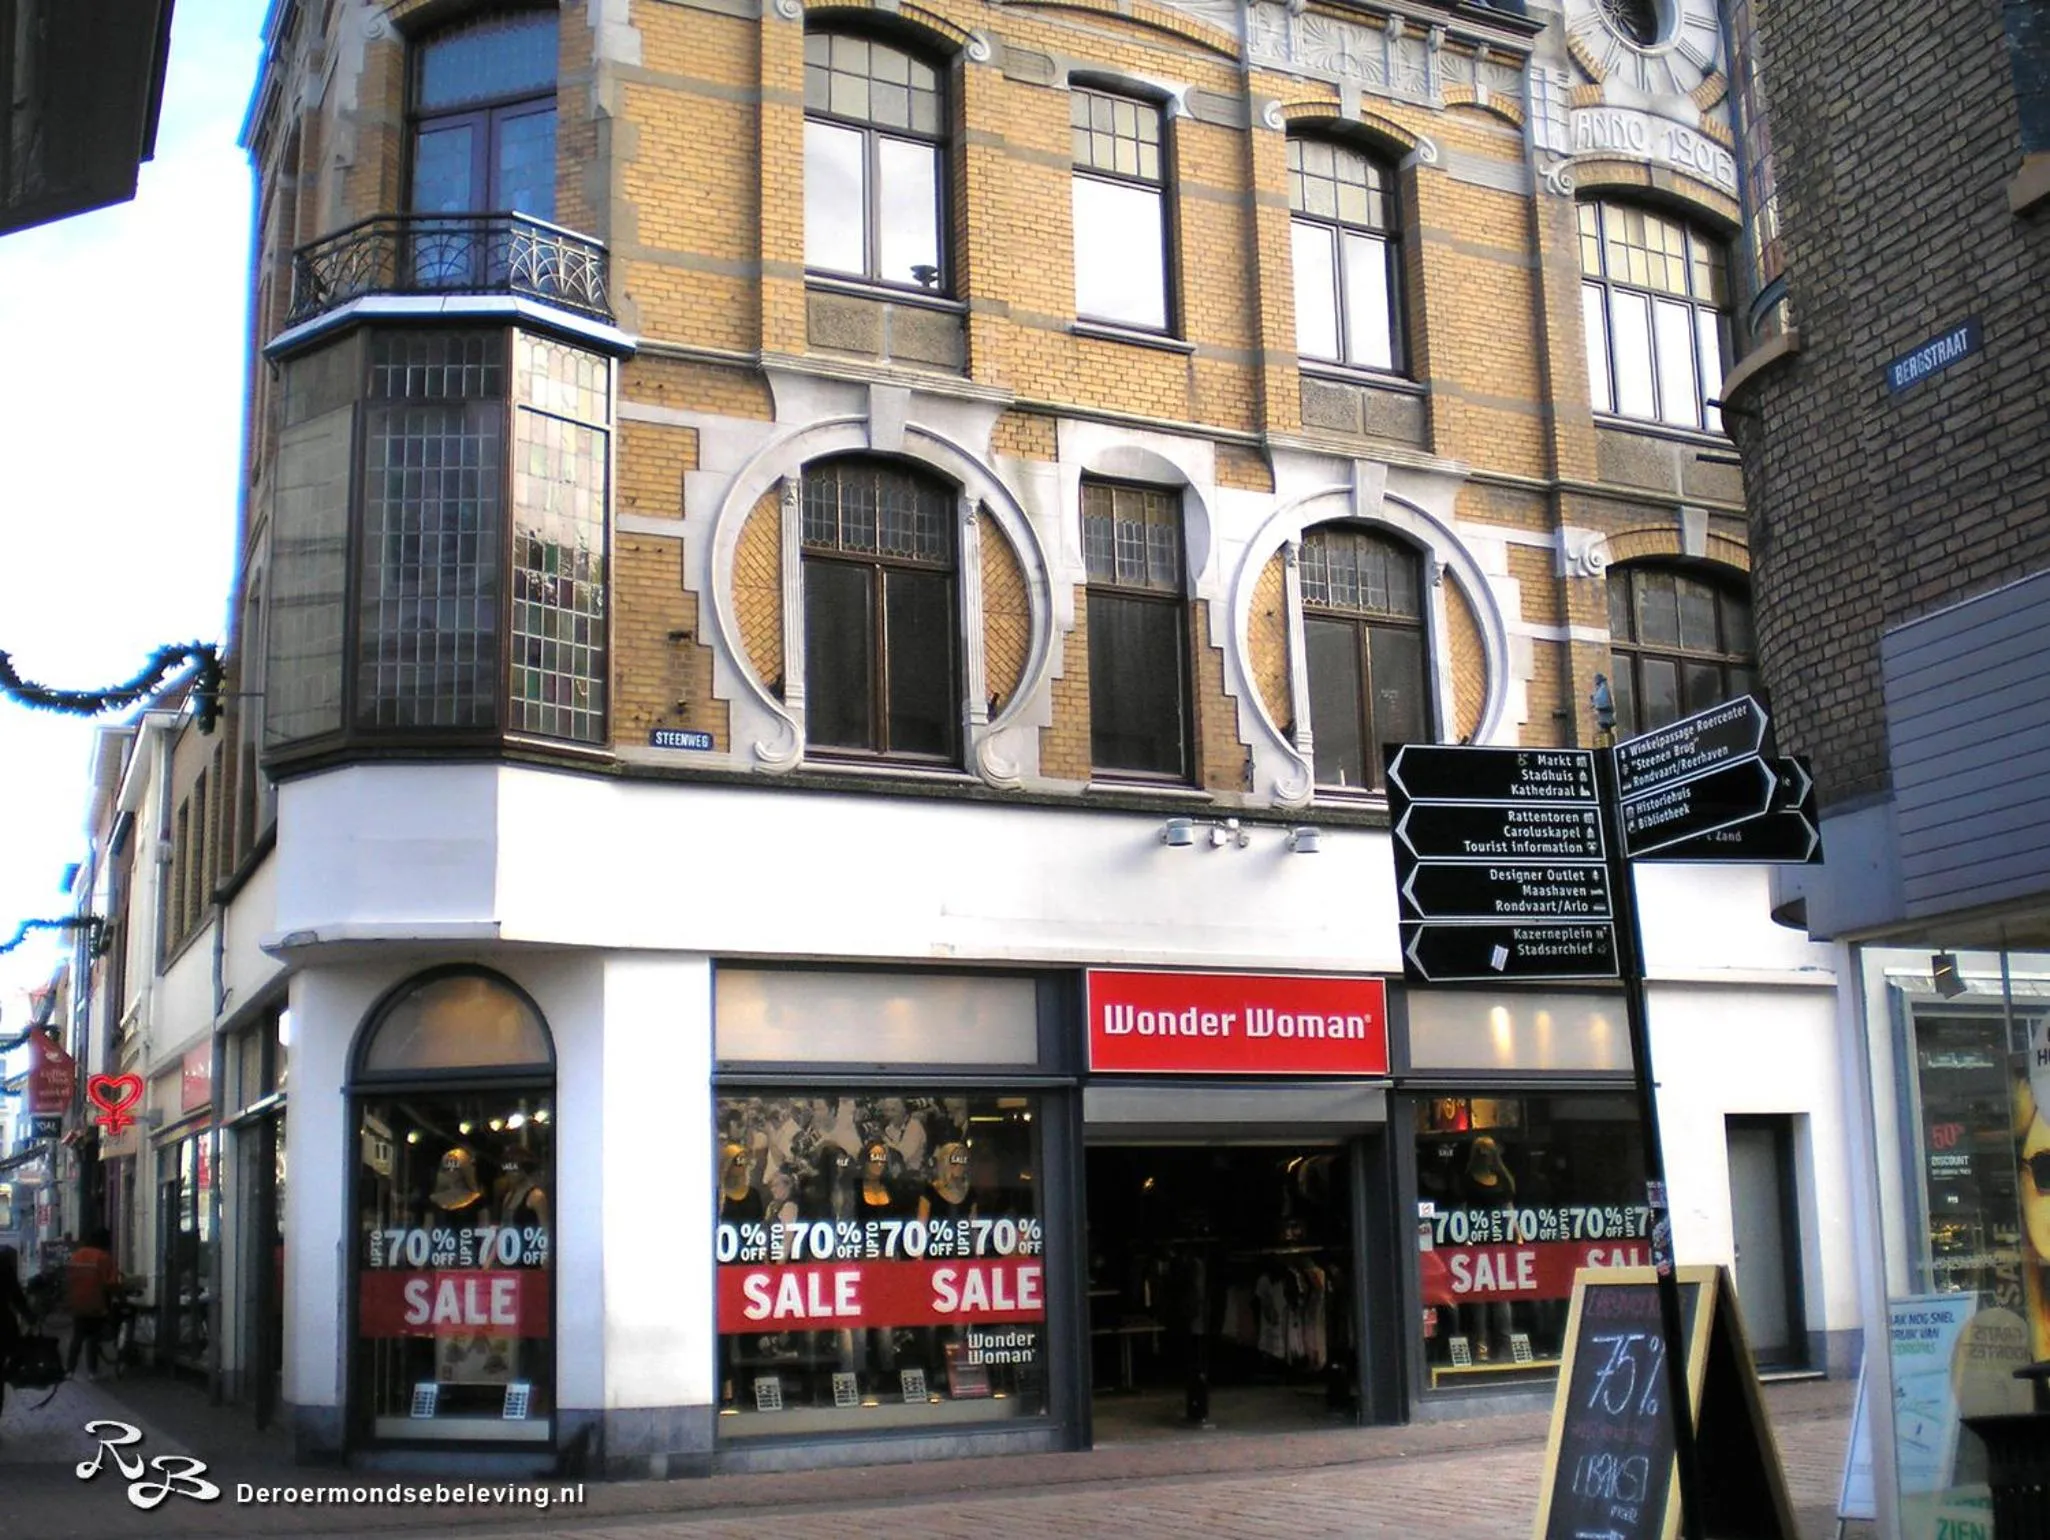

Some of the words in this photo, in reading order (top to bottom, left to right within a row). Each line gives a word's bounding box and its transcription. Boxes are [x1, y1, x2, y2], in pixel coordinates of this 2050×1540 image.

[1576, 112, 1645, 151] ANNO
[1667, 126, 1735, 189] 1906
[1894, 327, 1968, 386] BERGSTRAAT
[1629, 725, 1694, 757] Winkelpassage
[1697, 703, 1748, 732] Roercenter
[655, 731, 709, 748] STEENWEG
[1537, 755, 1571, 766] Markt
[1633, 745, 1729, 787] Rondvaart/Roerhaven
[1521, 769, 1574, 781] Stadhuis
[1511, 784, 1576, 796] Kathedraal
[1636, 787, 1692, 812] Historiehuis
[1508, 811, 1579, 823] Rattentoren
[1638, 804, 1691, 830] Bibliotheek
[1503, 825, 1581, 840] Caroluskapel
[1464, 841, 1508, 853] Tourist
[1512, 841, 1584, 853] information
[1490, 869, 1542, 883] Designer
[1547, 869, 1585, 881] Outlet
[1522, 885, 1587, 897] Maashaven
[1495, 901, 1589, 914] Rondvaart/Arlo
[1514, 928, 1593, 942] Kazerneplein
[1517, 943, 1594, 956] Stadsarchief
[1104, 1005, 1236, 1037] Wonder
[1470, 1230, 1489, 1242] OFF
[1539, 1228, 1557, 1241] OFF
[1605, 1225, 1623, 1238] OFF
[431, 1252, 456, 1266] OFF
[522, 1250, 548, 1265] OFF
[740, 1247, 767, 1261] OFF
[836, 1245, 862, 1259] OFF
[929, 1243, 954, 1256] OFF
[1018, 1241, 1042, 1255] OFF
[1450, 1251, 1538, 1294] SALE
[404, 1278, 517, 1326] SALE
[743, 1271, 862, 1321] SALE
[931, 1267, 1043, 1313] SALE
[1930, 1311, 1955, 1324] SNEL
[967, 1332, 1036, 1349] Wonder
